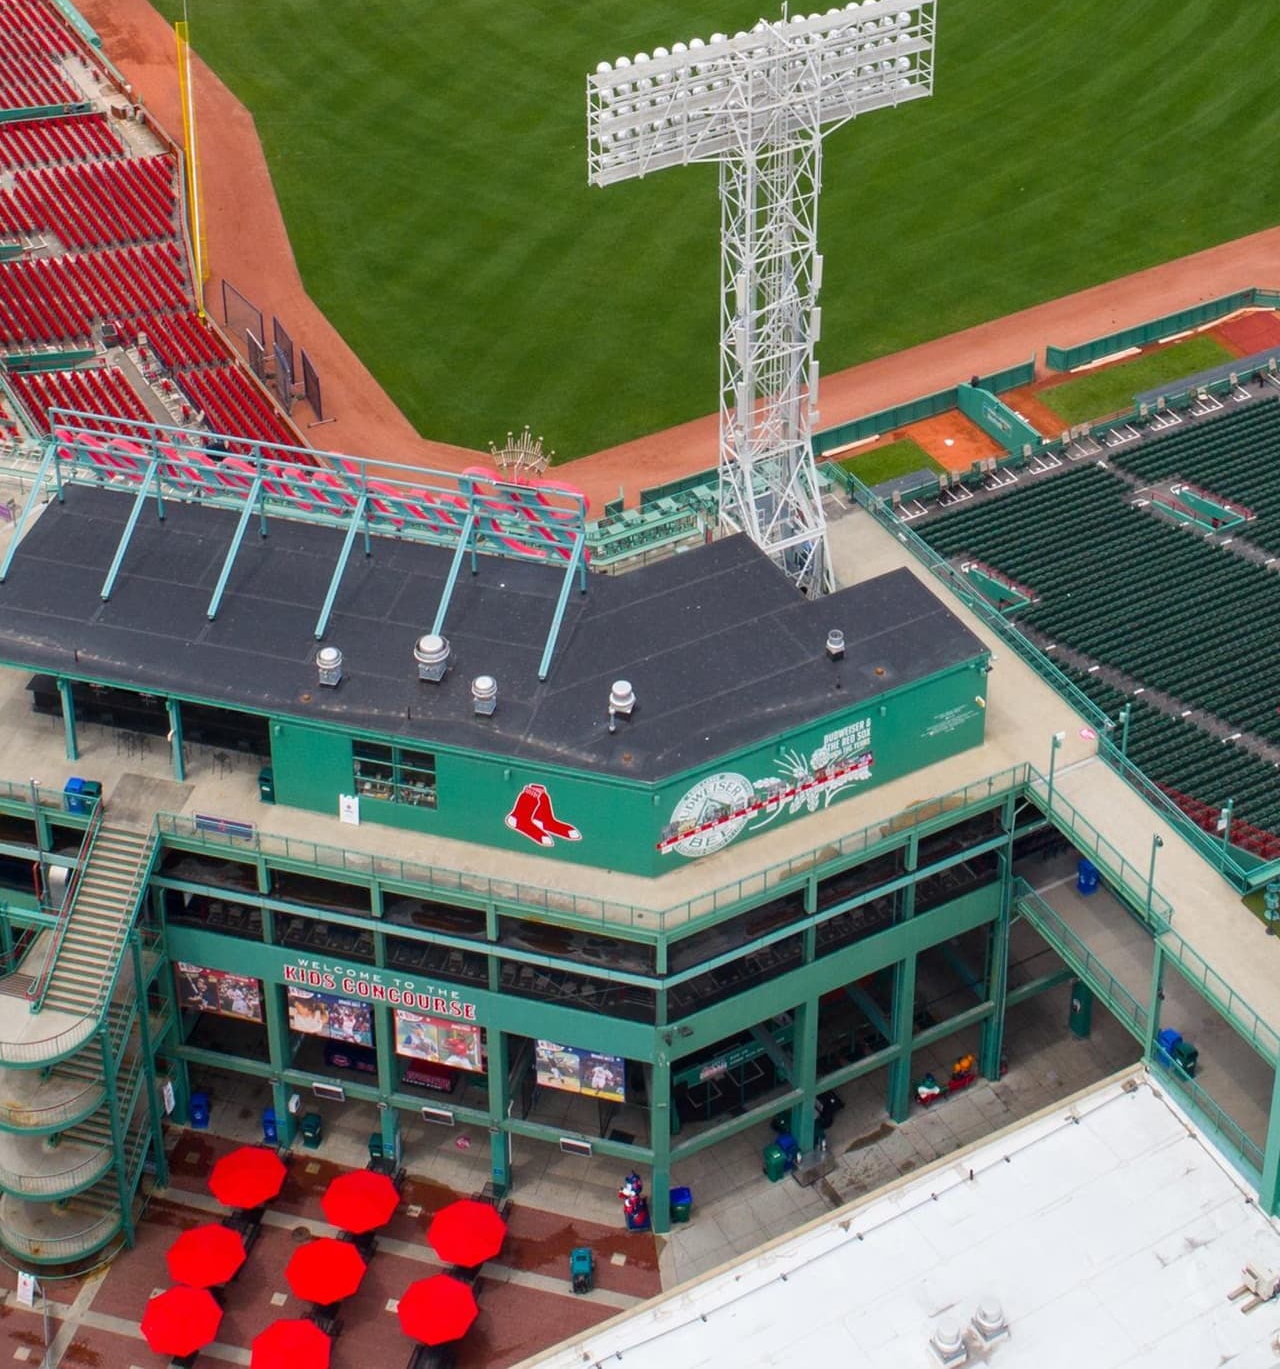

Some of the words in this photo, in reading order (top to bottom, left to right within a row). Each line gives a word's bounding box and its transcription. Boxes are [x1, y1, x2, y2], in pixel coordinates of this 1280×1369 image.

[826, 739, 840, 752] THE
[841, 734, 856, 747] RED
[857, 729, 871, 742] SOX
[283, 963, 336, 991] KIDS
[342, 977, 477, 1020] CONCOURSE
[297, 957, 382, 983] WELCOME
[393, 978, 416, 990] TO
[427, 984, 461, 1000] THE
